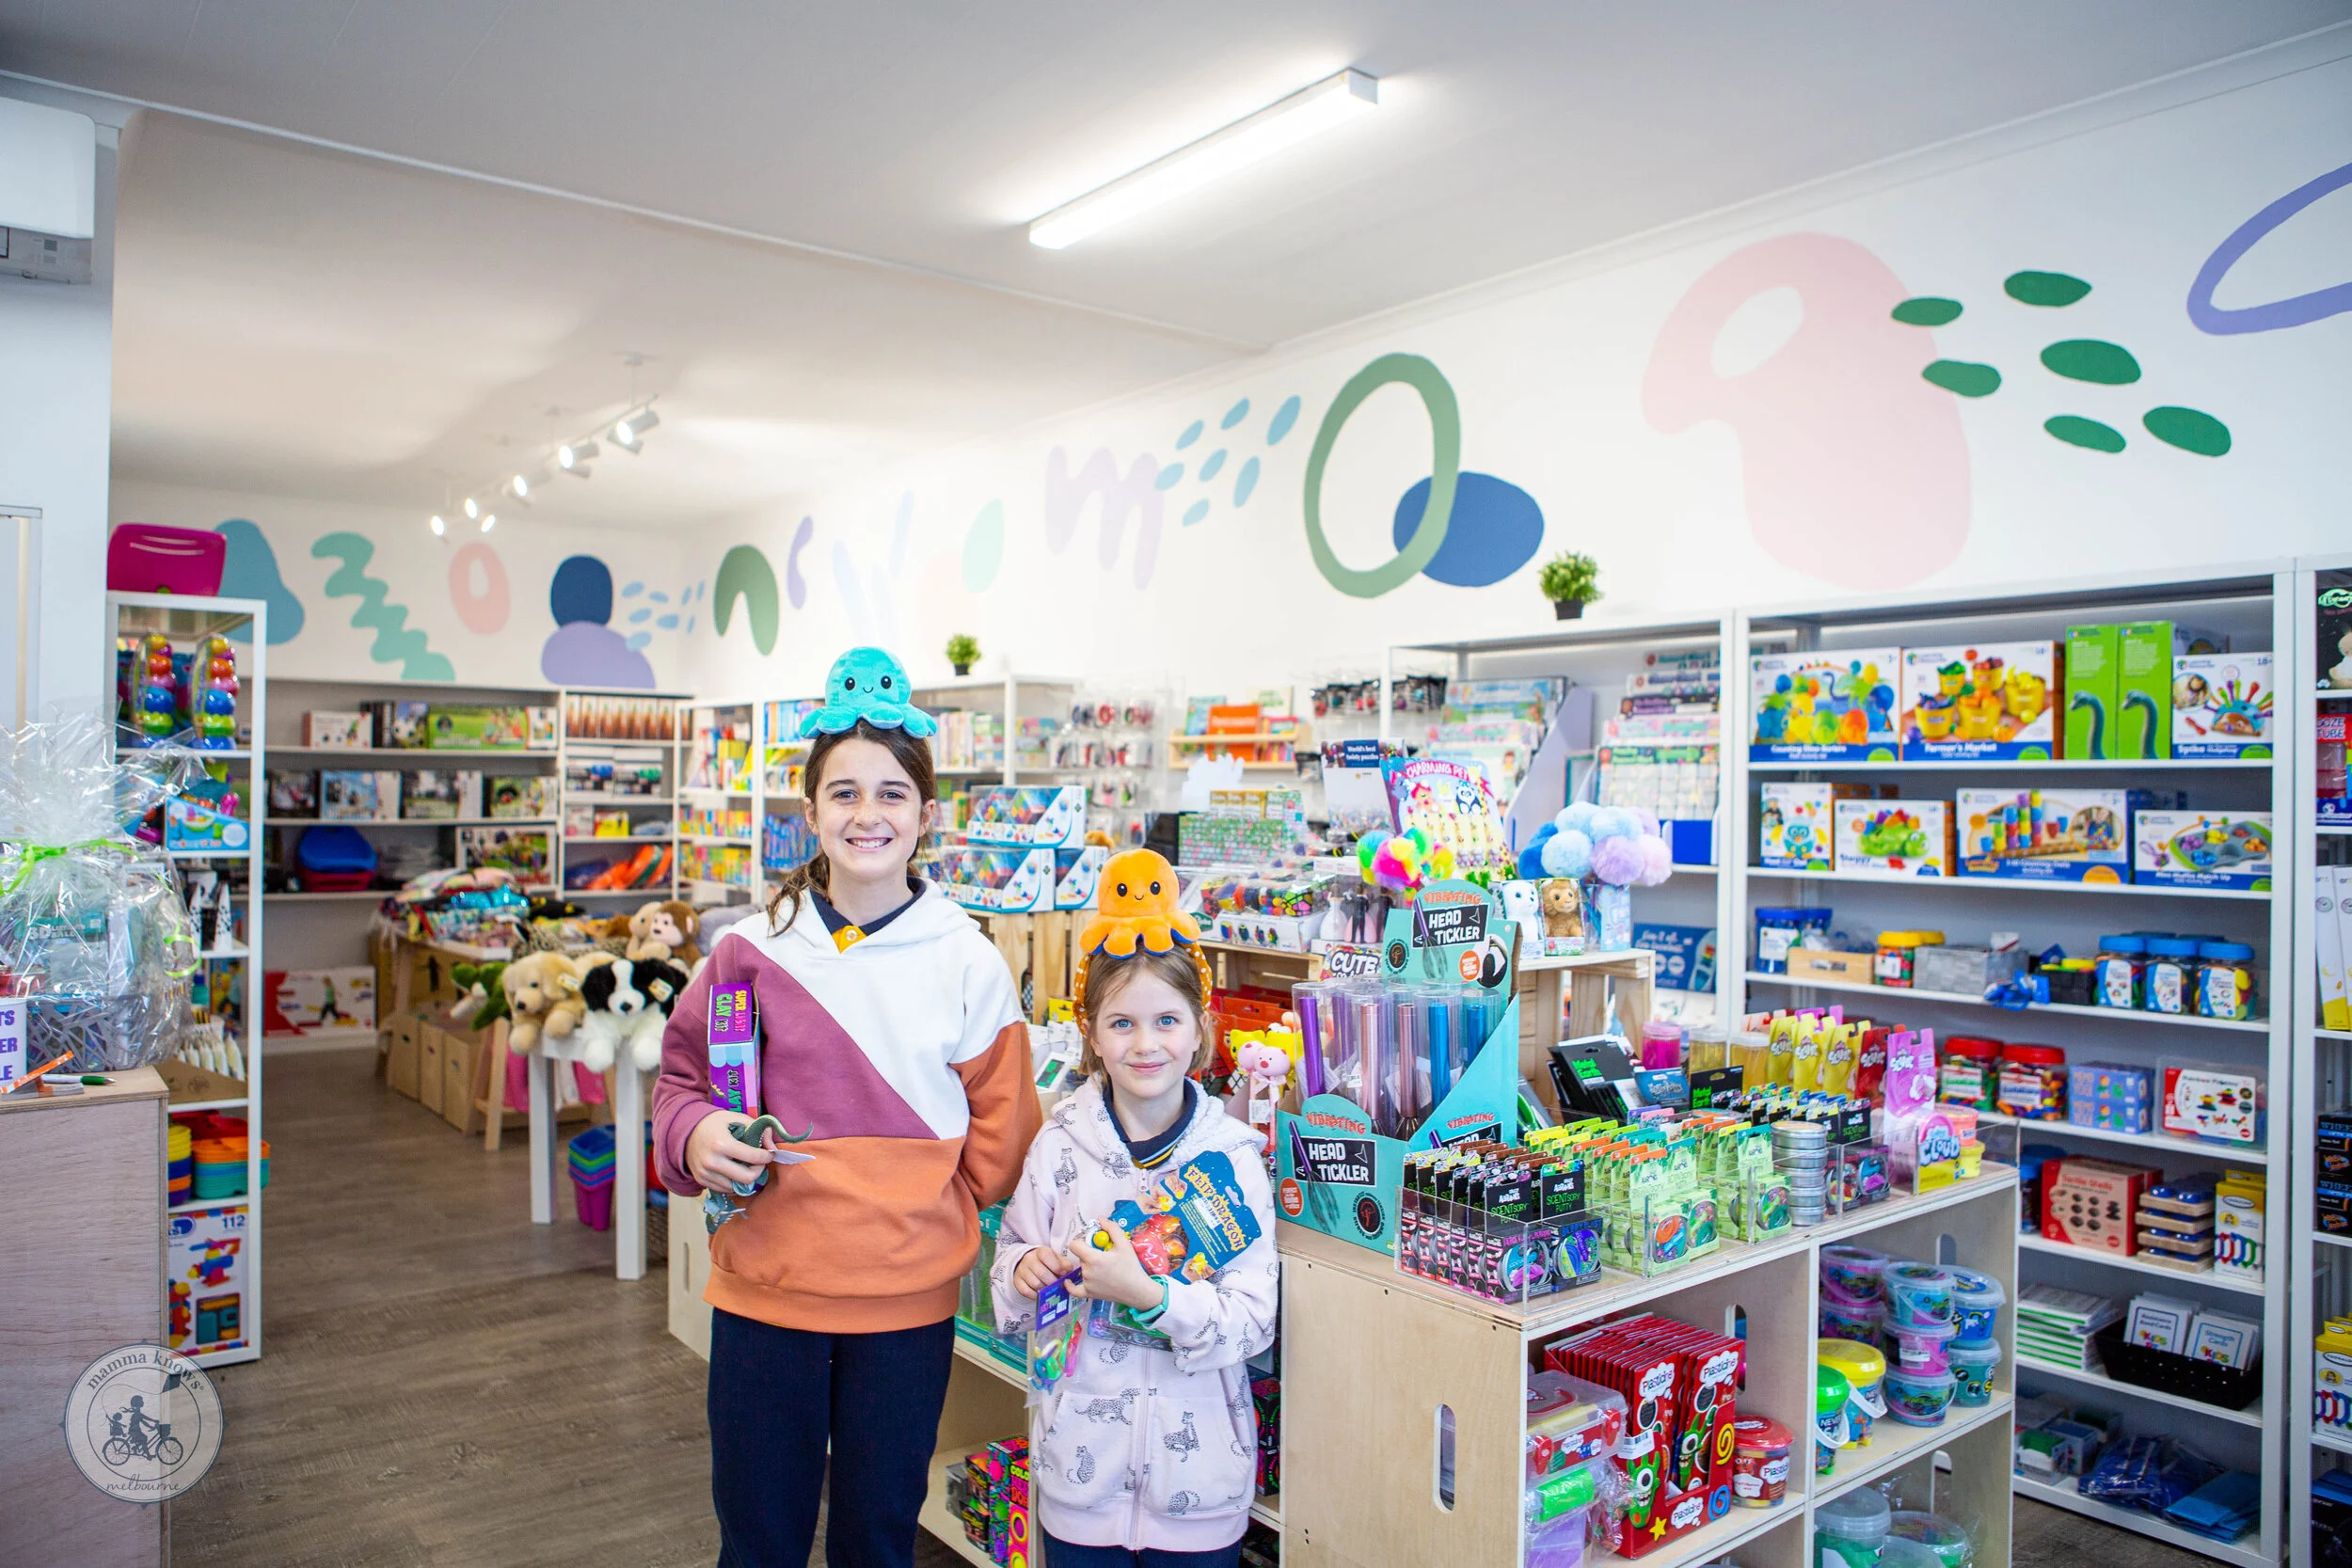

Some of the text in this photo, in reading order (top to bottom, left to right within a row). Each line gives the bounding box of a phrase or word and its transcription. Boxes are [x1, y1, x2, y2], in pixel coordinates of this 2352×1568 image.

[1423, 890, 1482, 906] VIBRATING
[1428, 909, 1462, 929] HEAD
[1434, 925, 1481, 945] TICKLER
[1329, 949, 1380, 976] CUTE
[0, 1009, 15, 1026] TS
[714, 993, 733, 1033] CLAY KIT
[726, 1069, 743, 1114] LAY KIT
[1305, 1112, 1367, 1135] VIBRATING
[1446, 1112, 1496, 1130] VIBRATING
[1308, 1142, 1347, 1162] HEAD
[1918, 1134, 1961, 1167] CLOUD
[1316, 1164, 1370, 1183] TICKLER
[1187, 1168, 1243, 1248] FLIP DRAGON
[1555, 1200, 1572, 1212] PUTTY
[221, 1214, 246, 1229] 112
[2208, 1338, 2229, 1348] Cards
